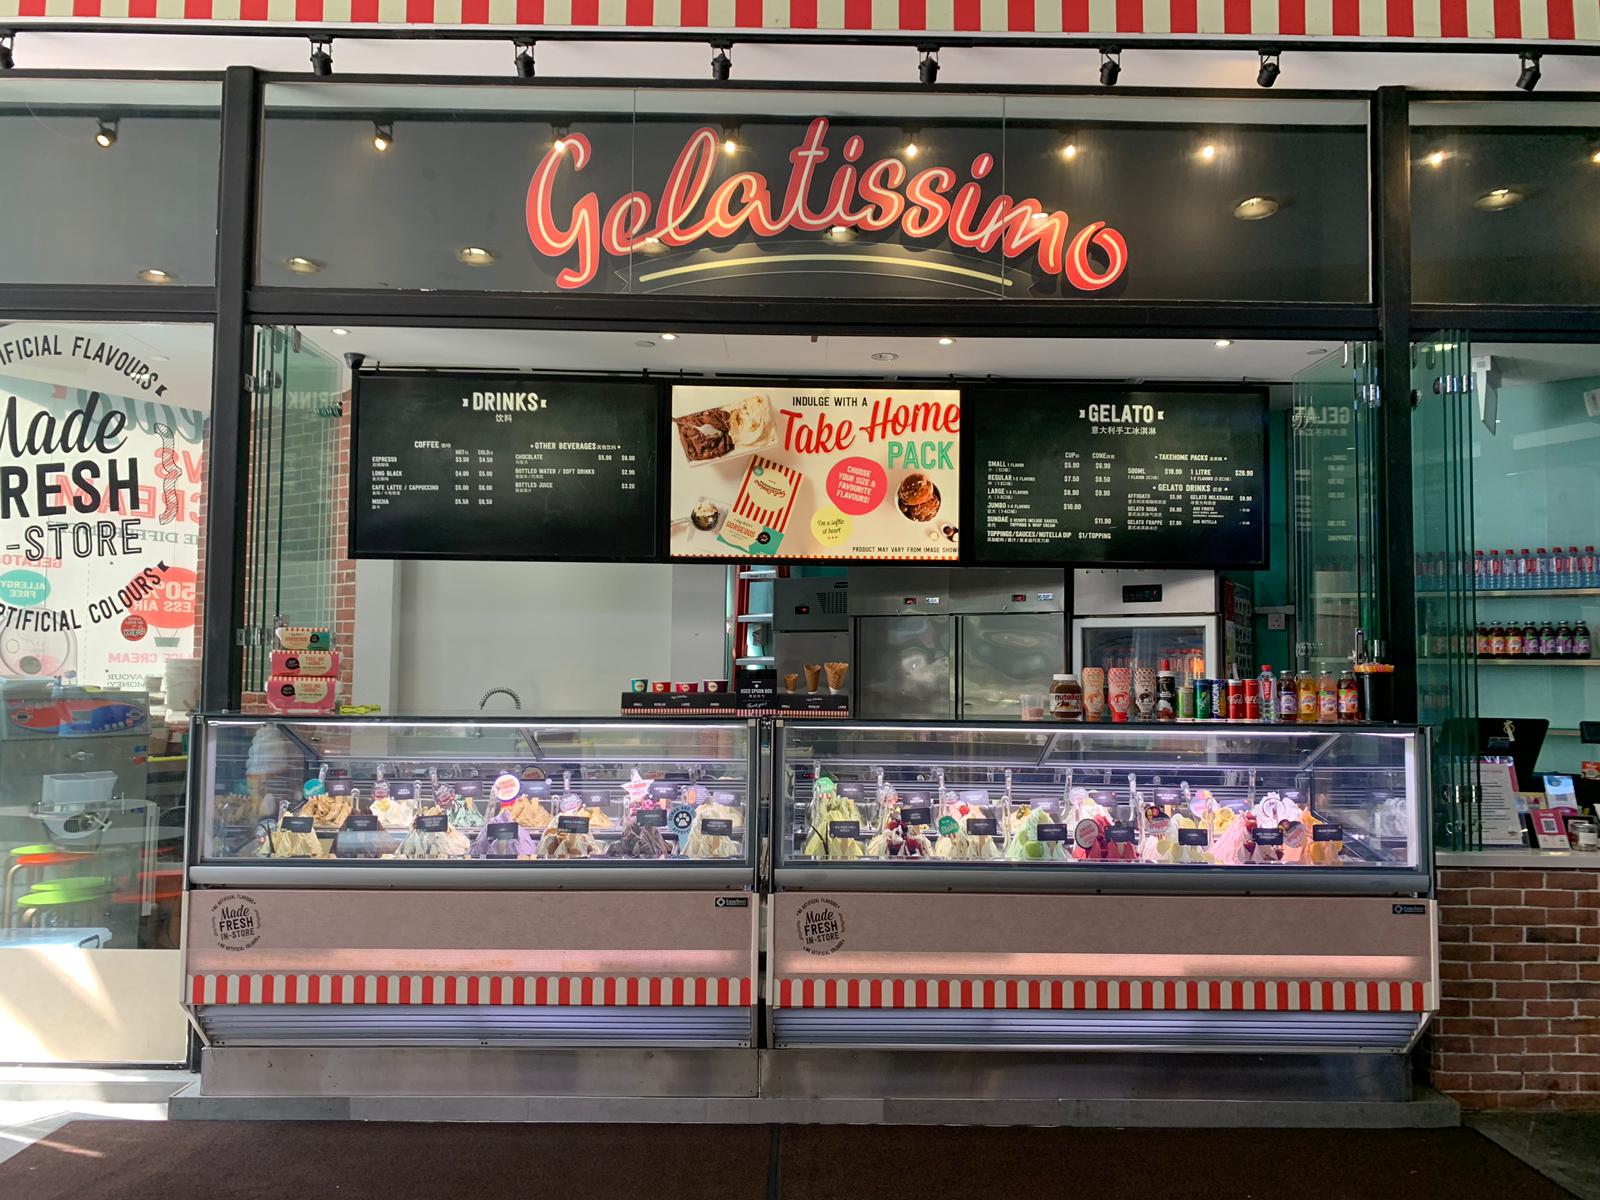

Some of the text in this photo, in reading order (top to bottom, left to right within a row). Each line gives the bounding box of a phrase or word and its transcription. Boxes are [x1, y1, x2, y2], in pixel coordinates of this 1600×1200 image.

[525, 117, 1128, 291] Gelatissimo
[72, 336, 158, 390] FLAVOURS
[472, 391, 540, 412] DRINKS
[792, 396, 868, 407] INDULGE WITH A
[1088, 404, 1154, 423] GELATO
[779, 396, 960, 455] Take Home
[414, 440, 440, 449] COFFEE
[534, 442, 597, 451] OTHER BEVERAGES
[887, 440, 954, 470] PACK
[846, 465, 872, 478] CHOOSE
[839, 472, 855, 484] YOUR
[855, 476, 870, 487] SIZE
[371, 484, 385, 492] CAFE
[386, 484, 403, 492] LATTE
[837, 482, 872, 495] FAVOURITE
[1157, 484, 1183, 492] GELATO
[1186, 484, 1211, 492] DRINKS
[371, 498, 390, 506] MOCHA
[88, 567, 161, 624] COLOURS
[221, 904, 250, 921] Made
[805, 908, 834, 925] Made
[219, 916, 254, 932] FRESH
[804, 920, 838, 936] FRESH
[220, 928, 255, 940] IN-STORE
[806, 932, 839, 945] IN-STORE
